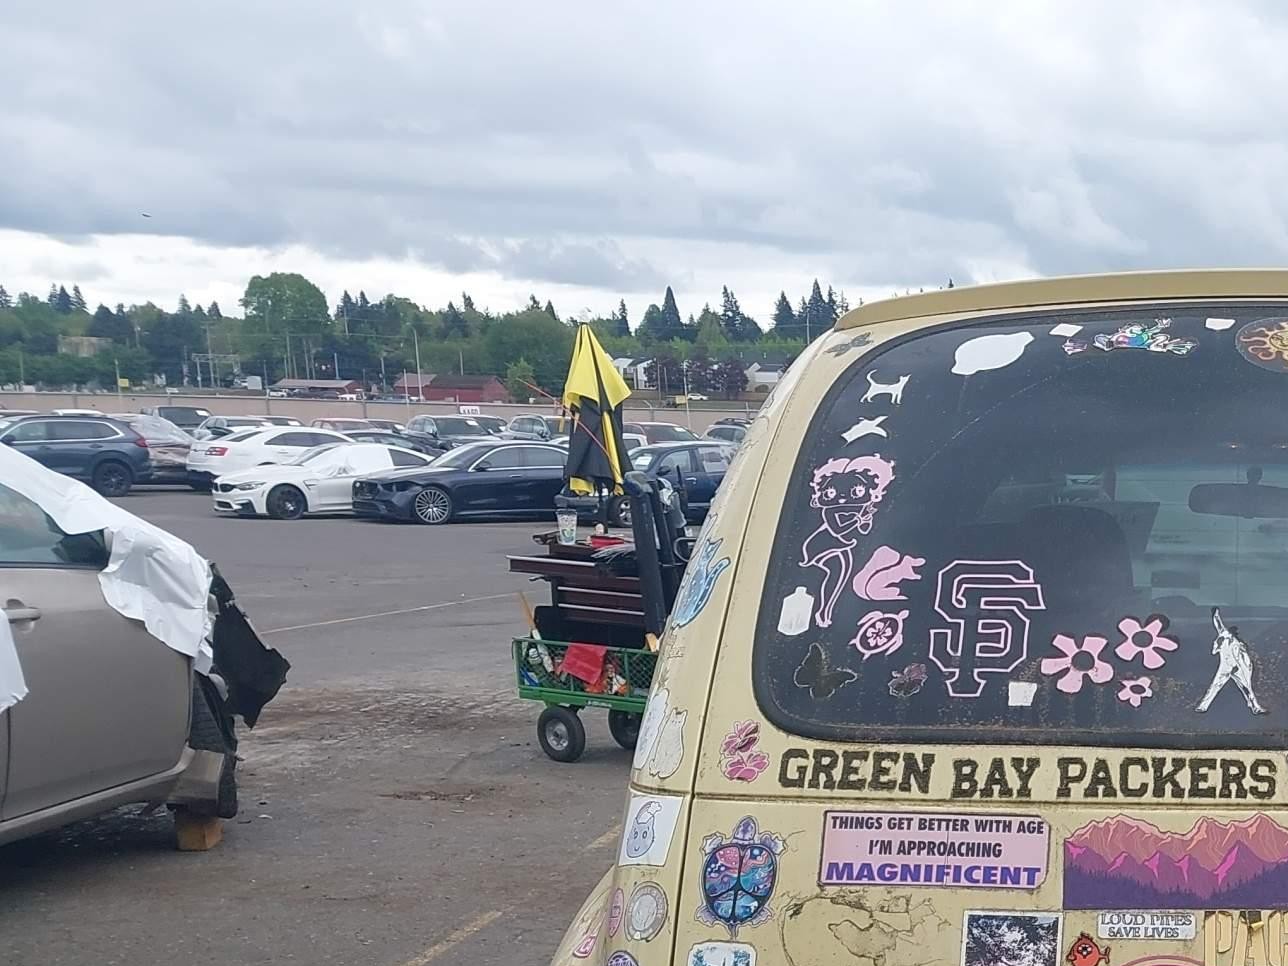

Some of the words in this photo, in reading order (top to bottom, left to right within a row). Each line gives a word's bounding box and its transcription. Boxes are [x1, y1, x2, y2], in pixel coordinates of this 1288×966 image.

[929, 560, 1046, 697] SF
[778, 748, 936, 794] GREEN
[951, 757, 1041, 799] BAY
[1056, 756, 1278, 800] PACKERS
[831, 816, 883, 830] THINGS
[888, 816, 914, 831] GET
[918, 817, 969, 832] BETTER
[974, 820, 1013, 834] WITH
[1016, 821, 1045, 835] AGE
[868, 839, 893, 856] I'M
[896, 840, 1003, 858] APPROACHING
[825, 862, 1042, 886] MAGNIFICENT
[1101, 913, 1146, 925] LOUD
[1150, 914, 1193, 926] PIPES
[1107, 926, 1141, 938] SAVE
[1143, 926, 1180, 938] LIVES
